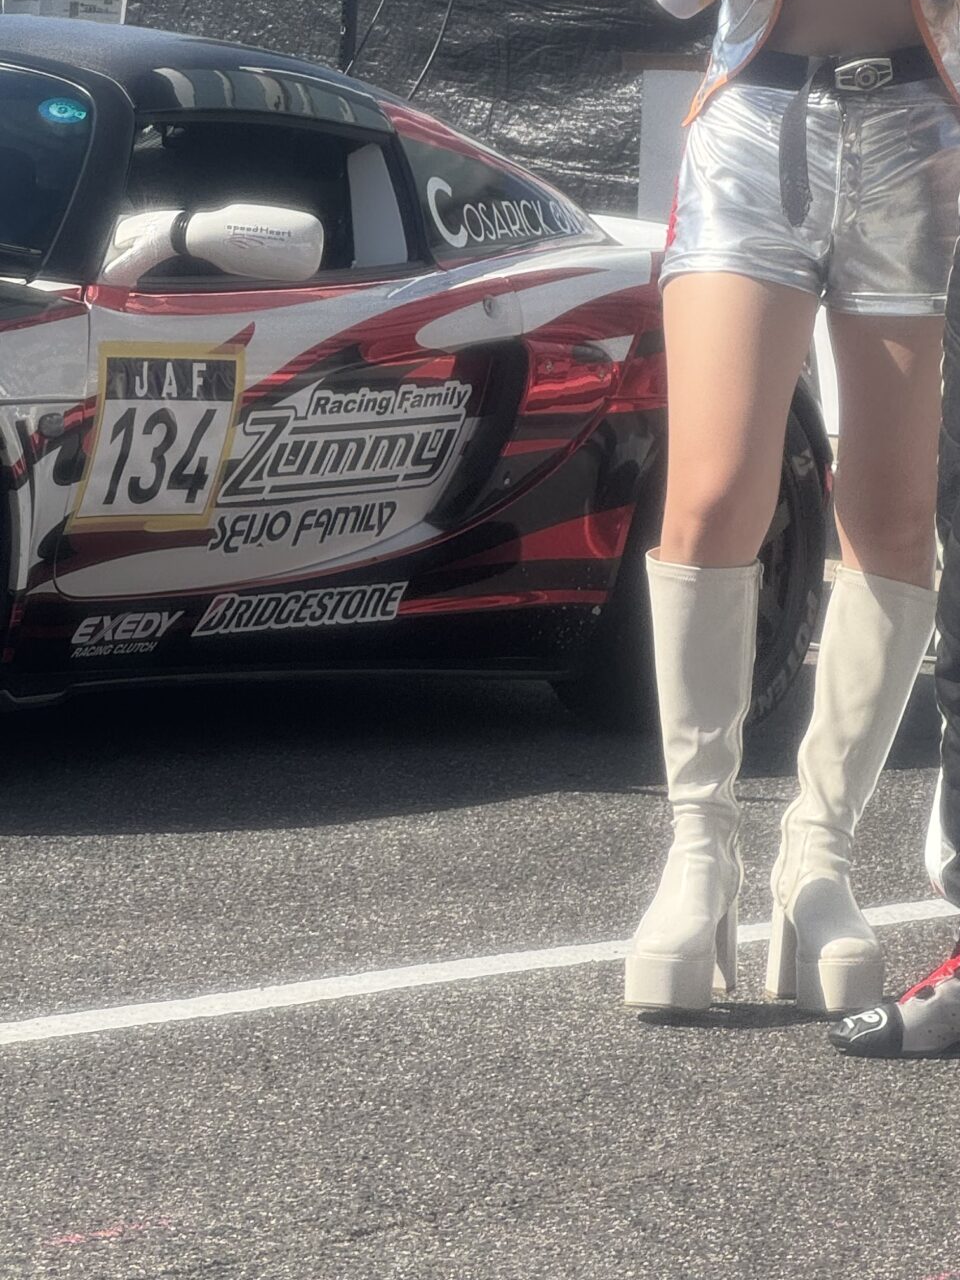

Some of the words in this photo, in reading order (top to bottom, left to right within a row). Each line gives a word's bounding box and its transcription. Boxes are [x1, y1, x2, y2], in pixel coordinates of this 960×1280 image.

[426, 176, 556, 249] COSARICK
[134, 361, 207, 399] JAF
[312, 392, 396, 415] Racing
[397, 387, 469, 411] Family
[102, 407, 218, 505] 134
[70, 610, 185, 646] EXEDY
[191, 581, 409, 638] BRIDGESTONE
[70, 642, 113, 659] RACING
[113, 641, 158, 654] CLUTCH
